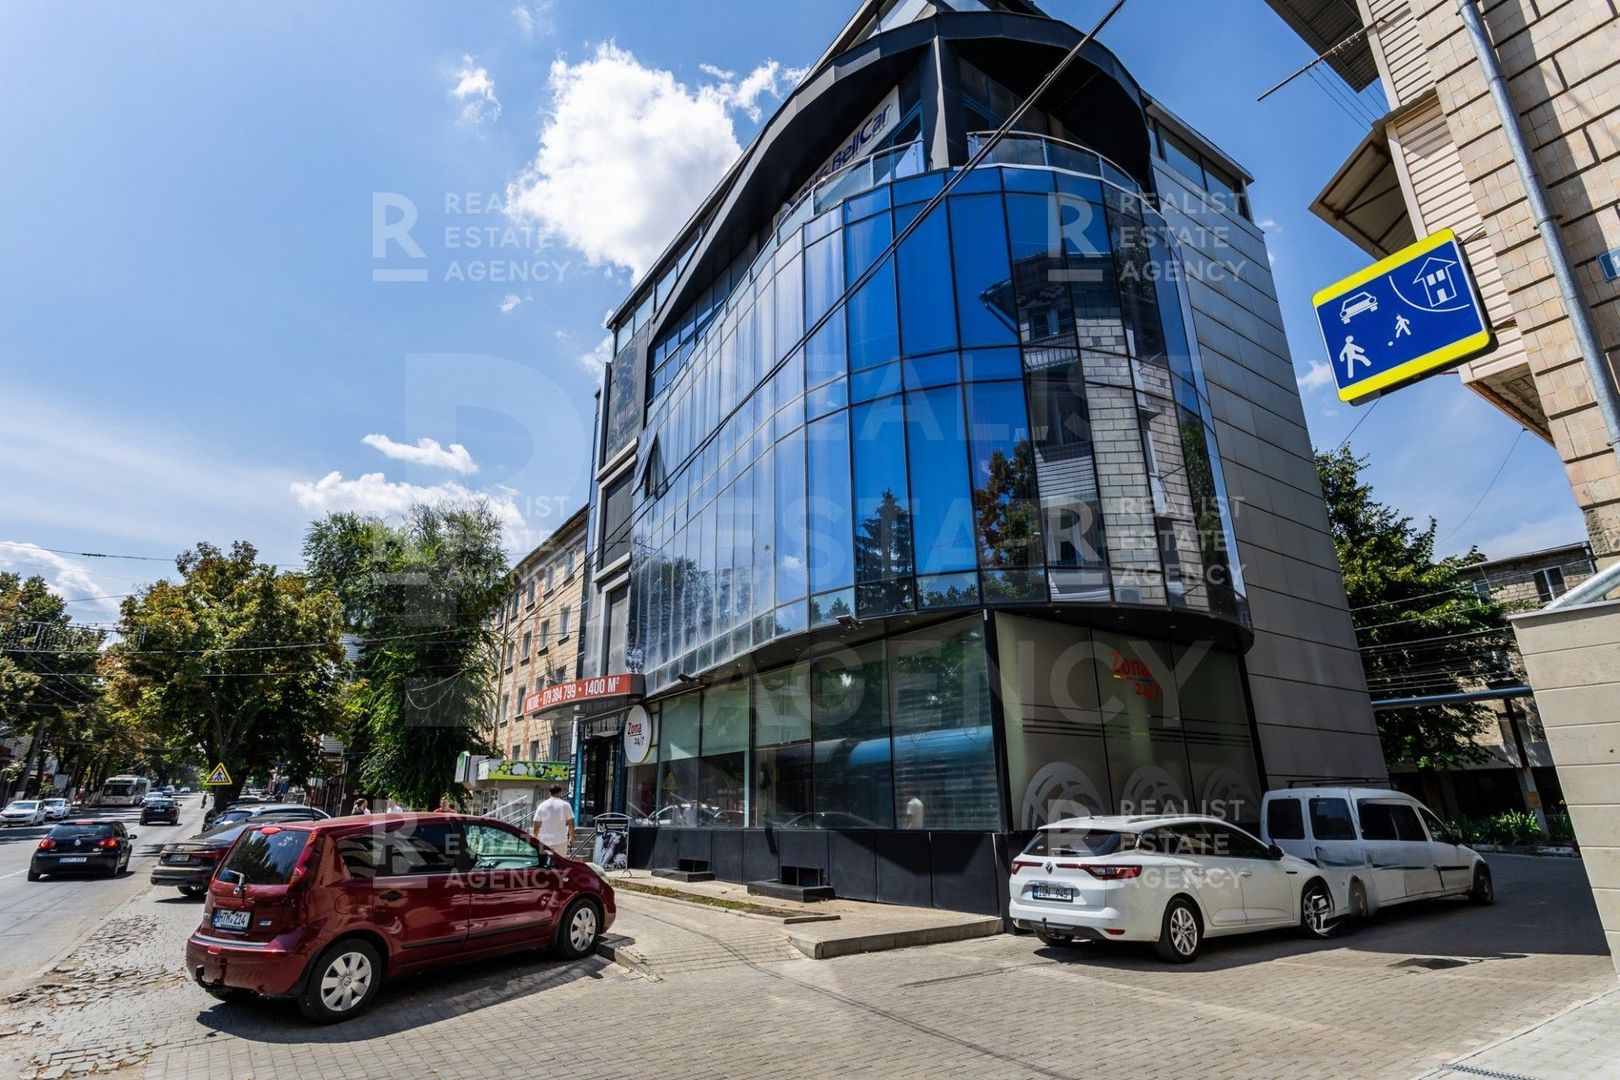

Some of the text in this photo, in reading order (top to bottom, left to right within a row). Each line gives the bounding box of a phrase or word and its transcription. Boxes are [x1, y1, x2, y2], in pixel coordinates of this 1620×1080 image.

[1109, 650, 1153, 678] Zona
[563, 683, 577, 700] 799
[585, 678, 605, 696] 1400
[628, 722, 642, 735] Zona
